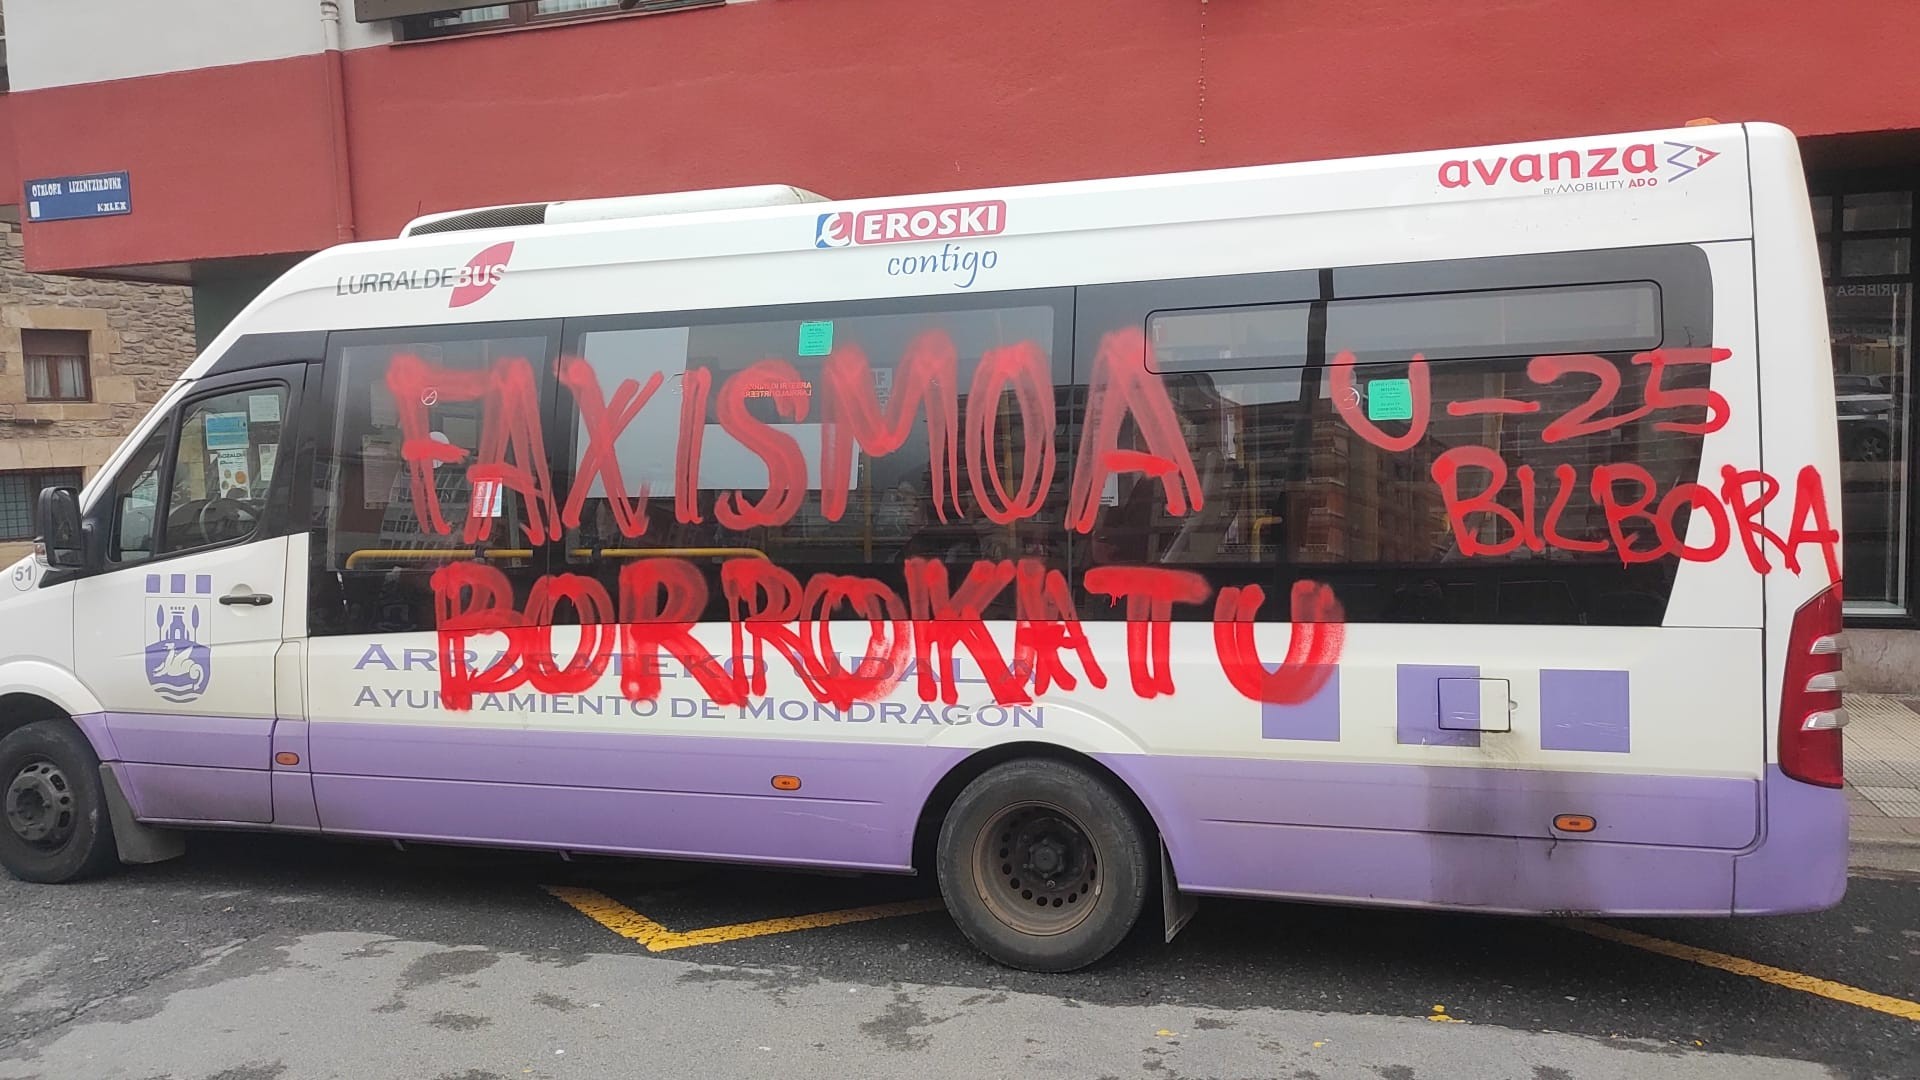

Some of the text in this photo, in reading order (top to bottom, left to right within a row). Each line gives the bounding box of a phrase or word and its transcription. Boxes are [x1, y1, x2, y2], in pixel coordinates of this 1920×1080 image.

[1437, 143, 1659, 189] avanza
[1556, 179, 1625, 194] MOBILITY
[1628, 177, 1658, 189] ADO
[862, 204, 999, 241] EROSKI
[887, 243, 998, 289] contigo
[385, 326, 1205, 545] FAXISMOA
[1431, 445, 1843, 592] BILBORA
[14, 565, 33, 582] 51
[430, 556, 1345, 711] BORROKATU
[671, 697, 726, 719] DE
